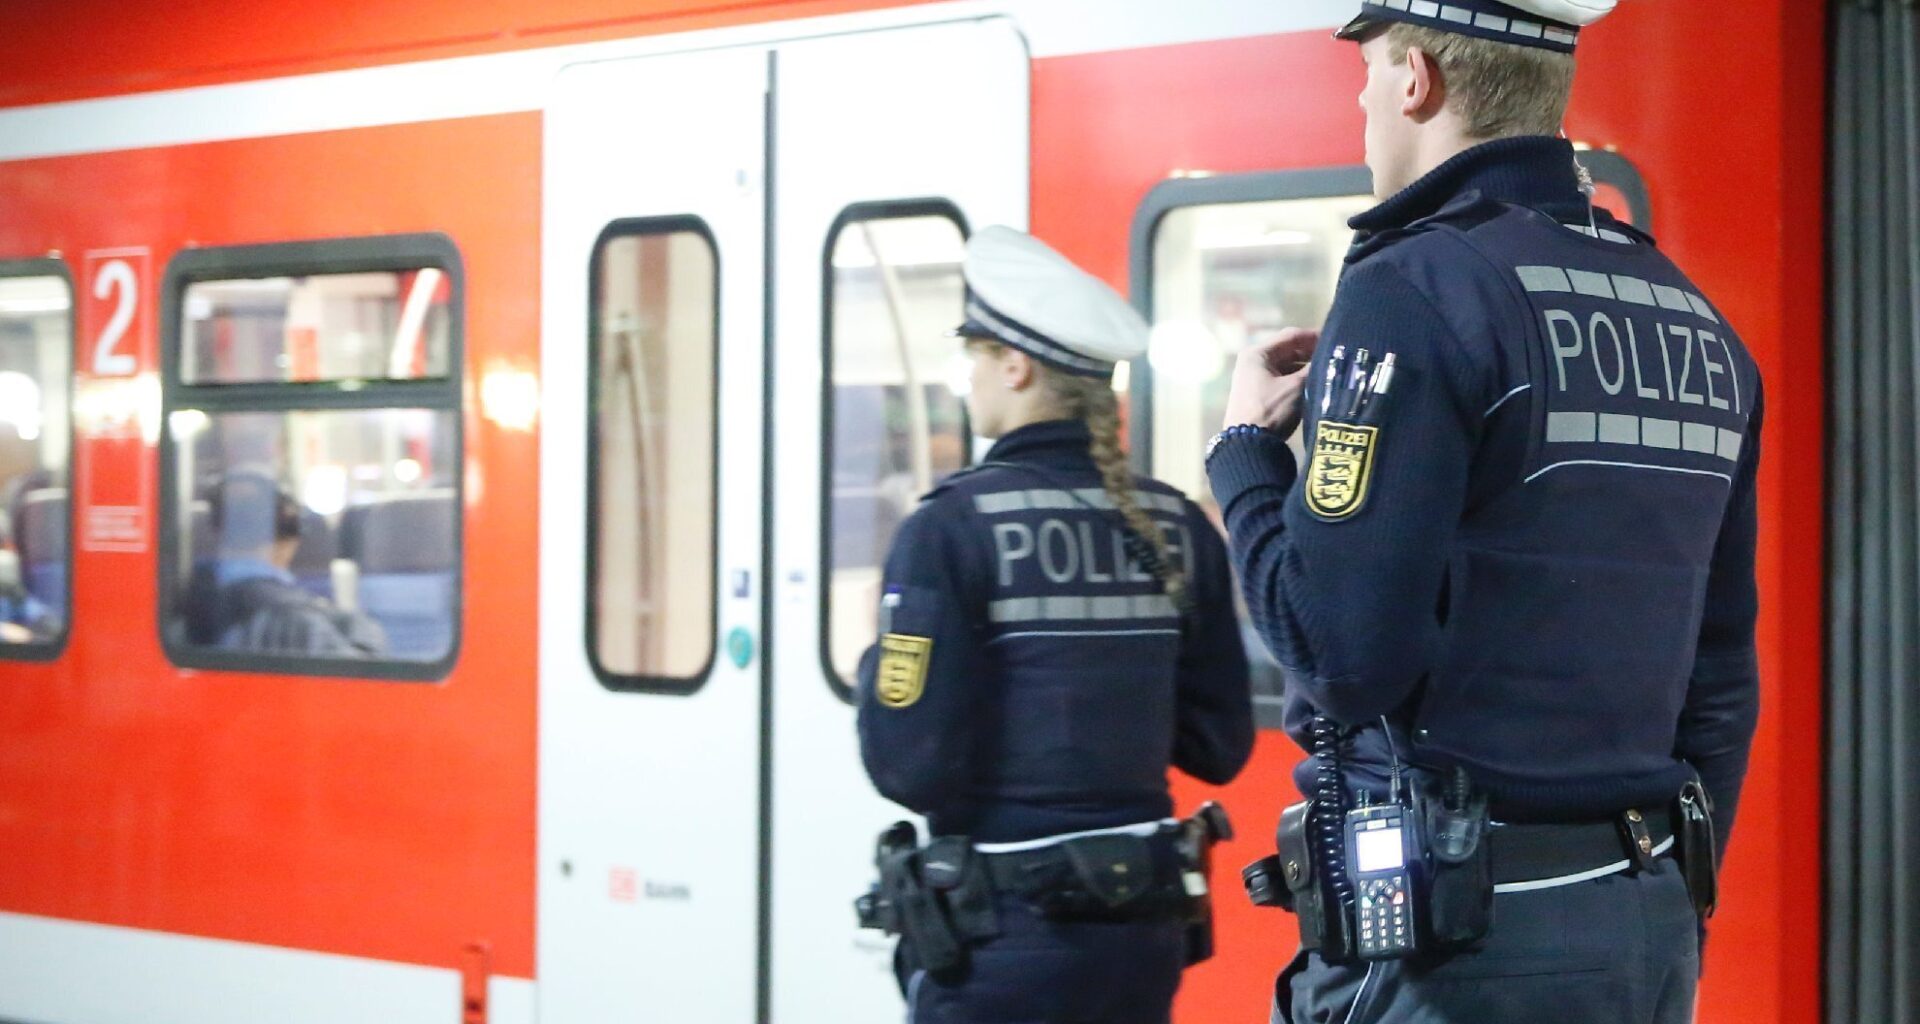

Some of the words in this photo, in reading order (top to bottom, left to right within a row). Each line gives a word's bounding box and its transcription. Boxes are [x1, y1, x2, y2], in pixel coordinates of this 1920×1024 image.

[94, 260, 137, 374] 2
[1544, 309, 1740, 414] POLIZEI
[1318, 427, 1369, 447] POLIZEI
